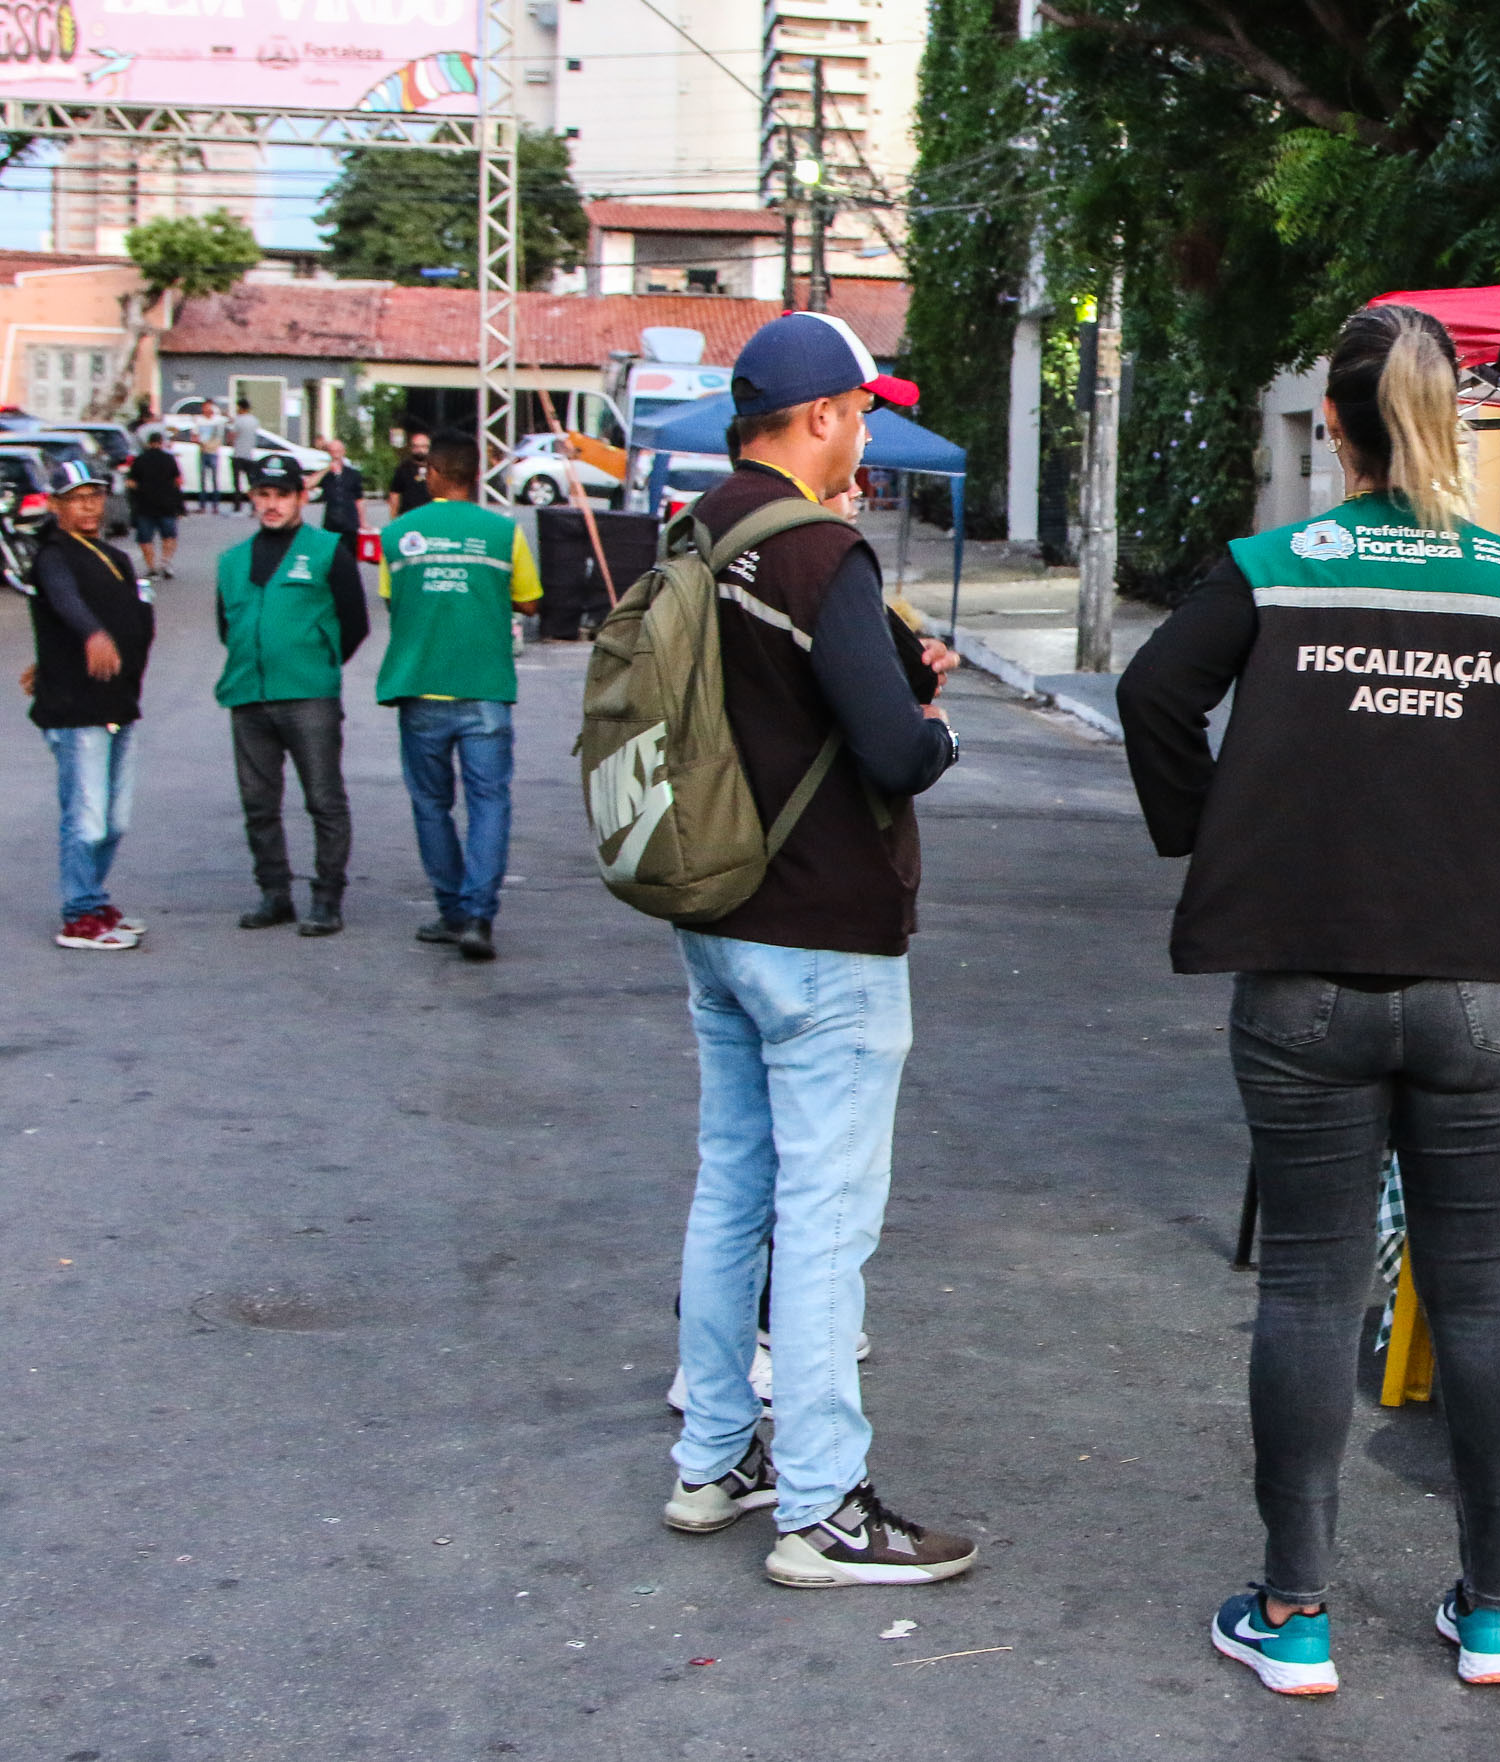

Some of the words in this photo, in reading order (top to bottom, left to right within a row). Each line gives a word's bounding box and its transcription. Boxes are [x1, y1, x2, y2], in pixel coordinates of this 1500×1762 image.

[1355, 525, 1436, 538] Prefeitura
[1357, 537, 1463, 558] Fortaleza
[424, 567, 469, 580] APOIO
[1348, 686, 1464, 719] AGEFIS
[590, 721, 666, 841] NIKE
